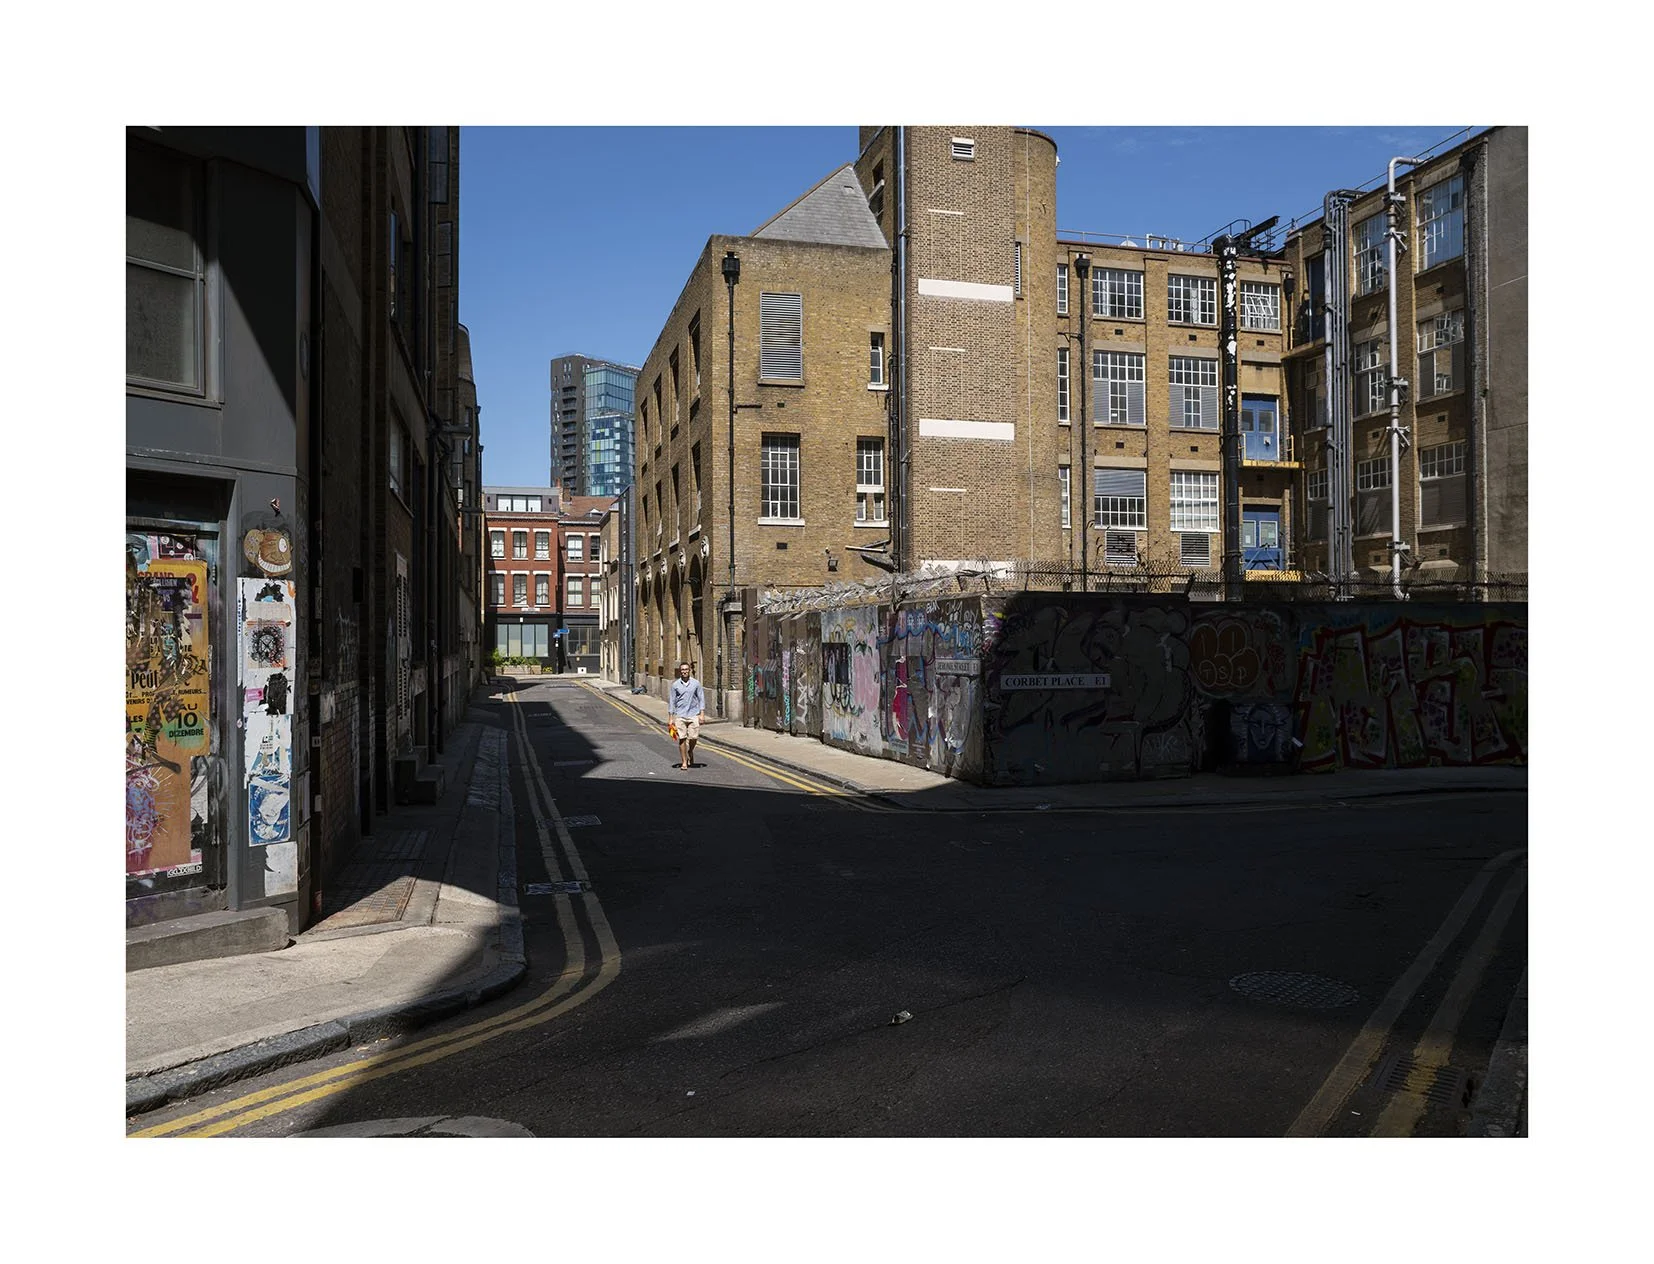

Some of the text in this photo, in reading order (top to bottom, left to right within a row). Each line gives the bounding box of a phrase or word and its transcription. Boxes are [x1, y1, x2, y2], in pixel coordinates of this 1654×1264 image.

[1005, 676, 1106, 687] CORBET PLACE E1
[178, 712, 198, 729] 10
